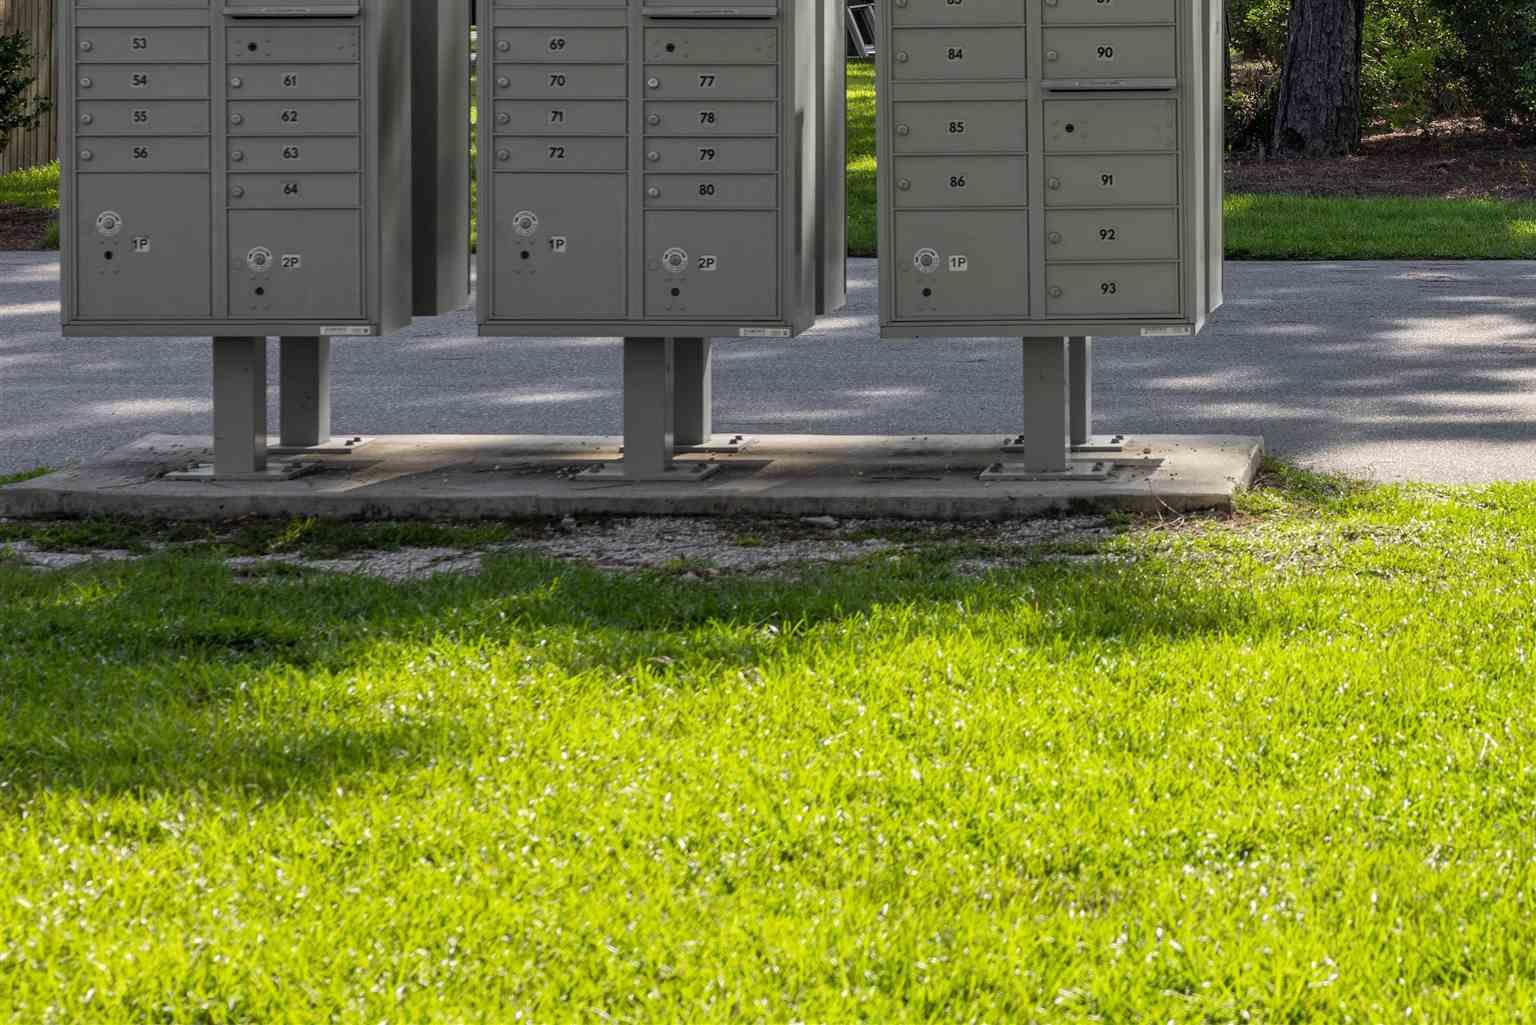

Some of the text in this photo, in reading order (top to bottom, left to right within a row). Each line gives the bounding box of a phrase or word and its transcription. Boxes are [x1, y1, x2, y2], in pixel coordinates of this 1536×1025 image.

[133, 37, 146, 49] 53
[550, 38, 565, 50] 69
[948, 48, 963, 60] 84
[1097, 46, 1113, 58] 90
[133, 74, 147, 86] 54
[283, 75, 296, 87] 61
[550, 75, 566, 87] 70
[700, 75, 715, 87] 77
[134, 110, 147, 122] 55
[281, 110, 298, 122] 62
[551, 110, 563, 122] 71
[700, 112, 715, 124] 78
[949, 121, 964, 133] 85
[133, 147, 148, 159] 56
[283, 147, 299, 159] 63
[549, 146, 565, 159] 72
[700, 148, 715, 161] 79
[950, 175, 966, 188] 86
[1101, 174, 1113, 185] 91
[283, 183, 298, 195] 64
[699, 184, 715, 196] 80
[1099, 228, 1116, 240] 92
[132, 238, 149, 251] 1P
[548, 238, 565, 251] 1P
[281, 256, 299, 268] 2P
[698, 257, 715, 269] 2P
[950, 257, 967, 268] 1P
[1100, 282, 1117, 295] 93
